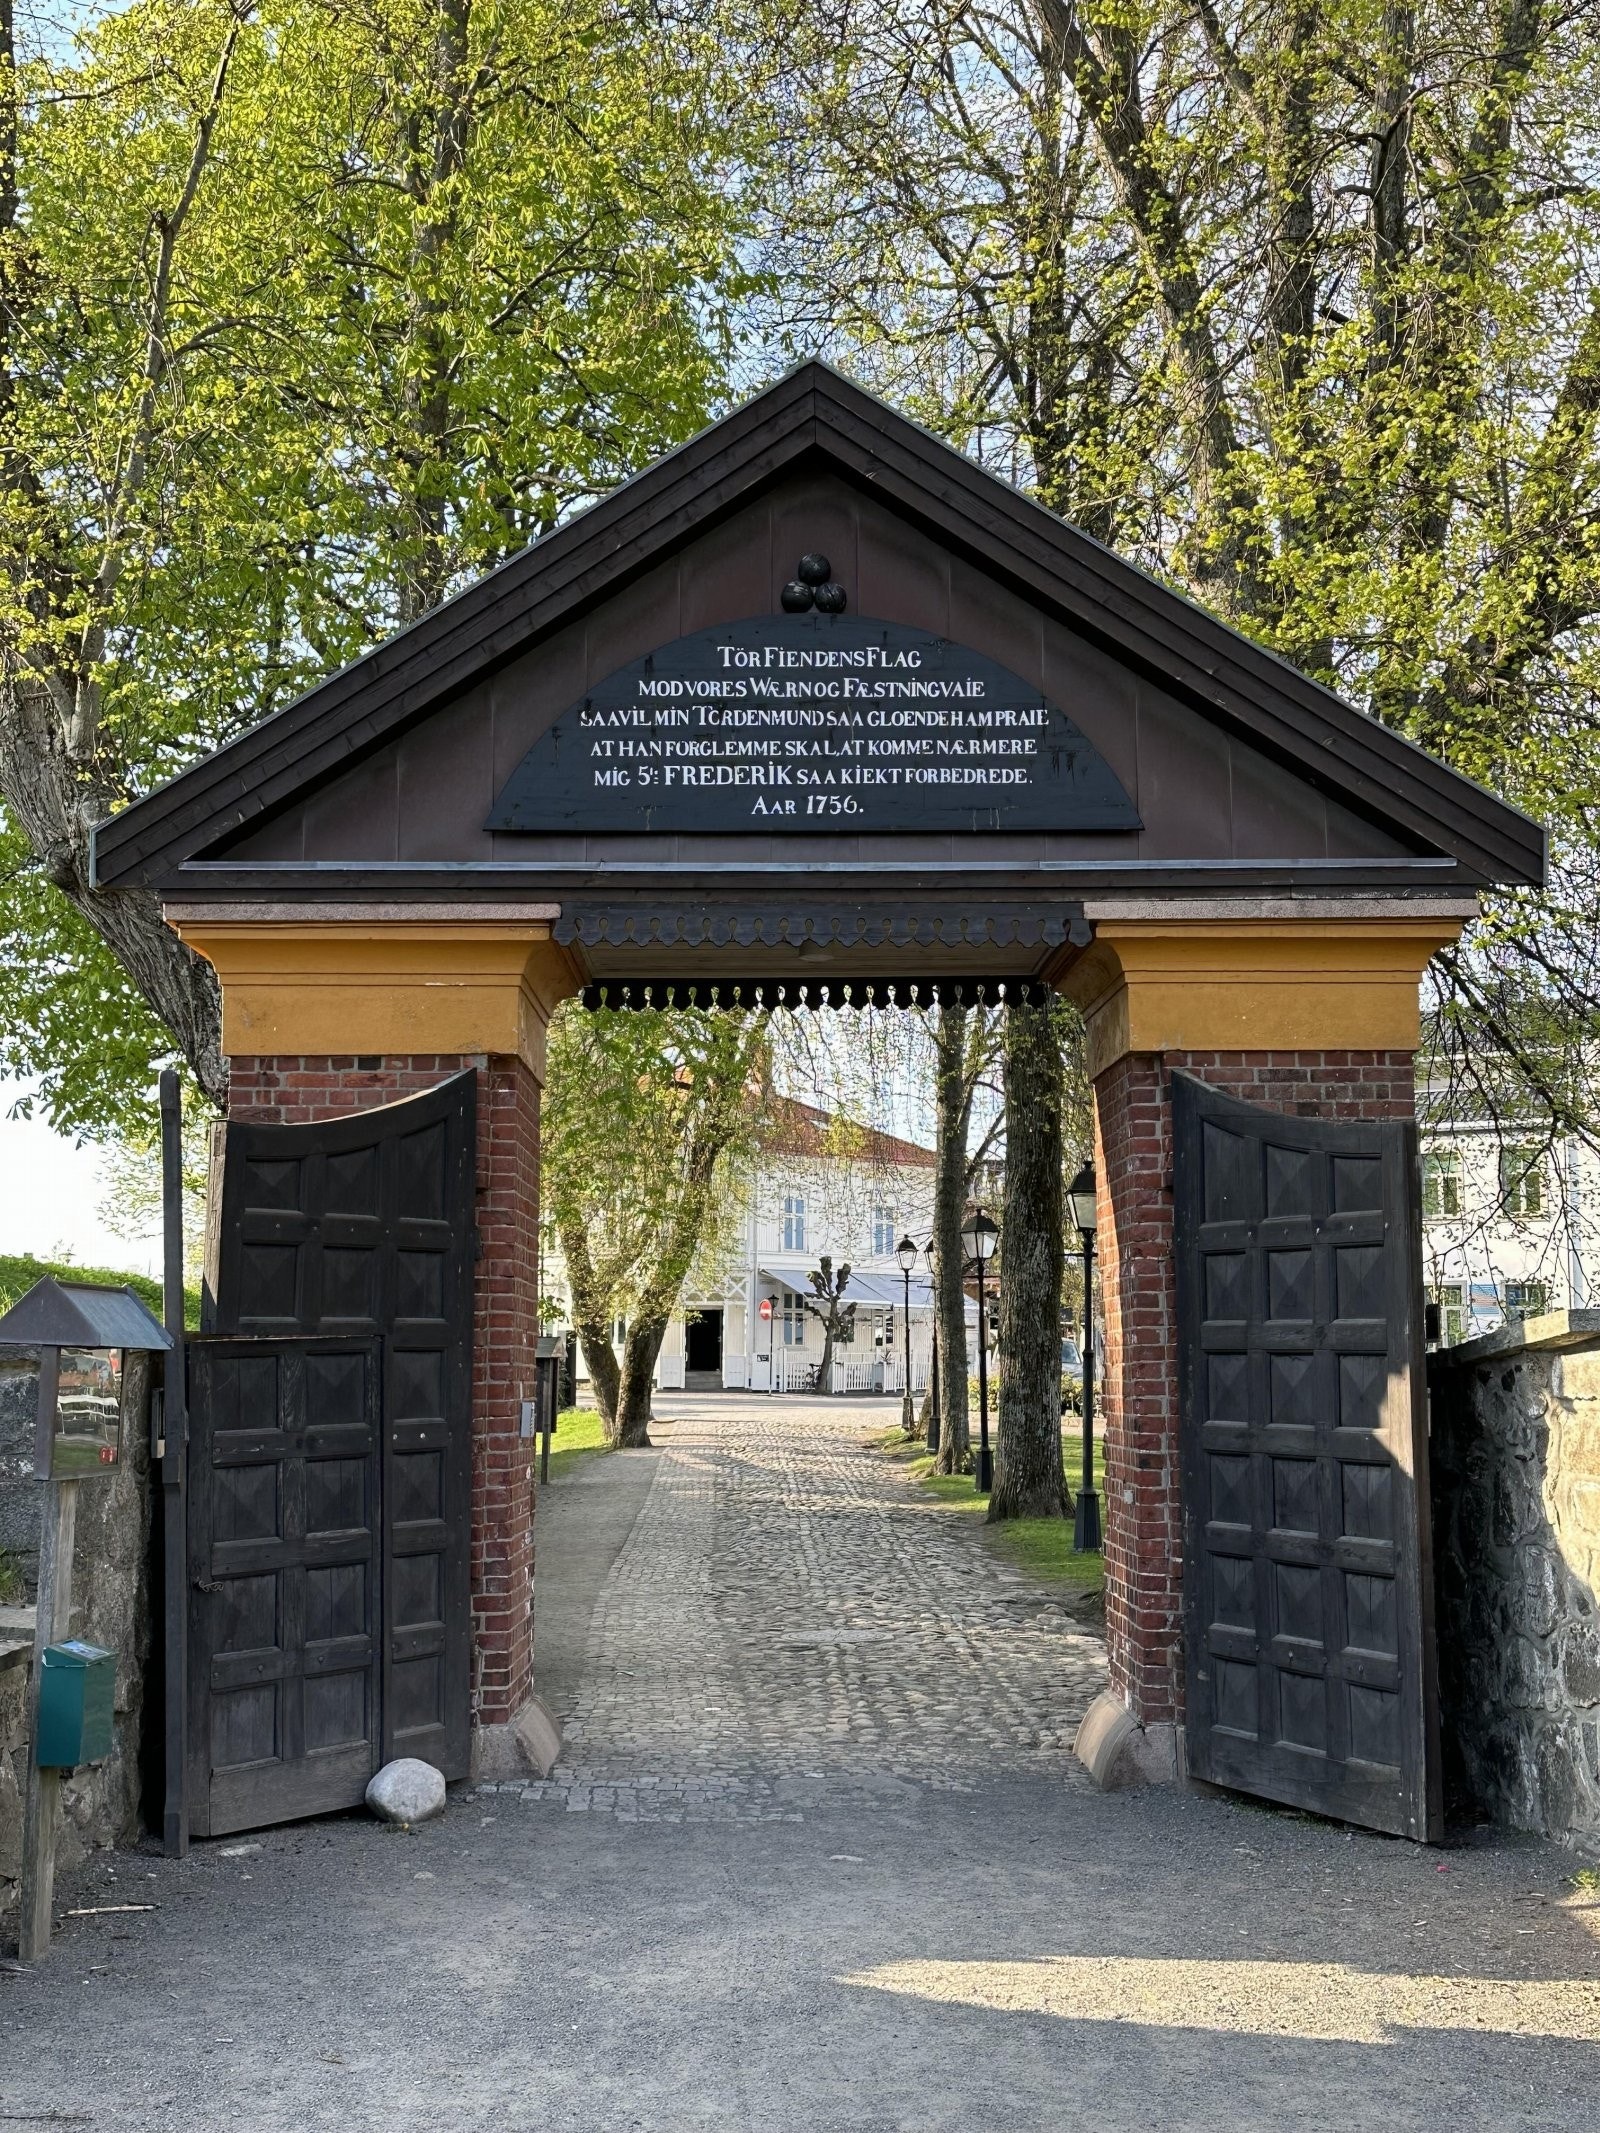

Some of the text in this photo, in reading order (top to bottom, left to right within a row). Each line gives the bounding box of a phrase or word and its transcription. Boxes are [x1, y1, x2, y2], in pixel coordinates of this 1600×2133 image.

[865, 646, 922, 668] FLAG
[638, 680, 684, 697] MOD
[683, 680, 749, 698] VORES
[748, 676, 812, 698] WÆRN
[813, 681, 841, 698] OG
[826, 710, 864, 727] SAA
[866, 710, 949, 727] GLOENDE
[590, 740, 615, 757] AT
[618, 740, 662, 757] HAN
[664, 740, 782, 757] FORGLEMME
[867, 739, 934, 756] KOMME
[936, 738, 1038, 755] NÆRMERE
[796, 768, 837, 785] SAA
[904, 767, 1033, 784] FORBEDREDE.
[751, 794, 864, 815] AAR 1756.
